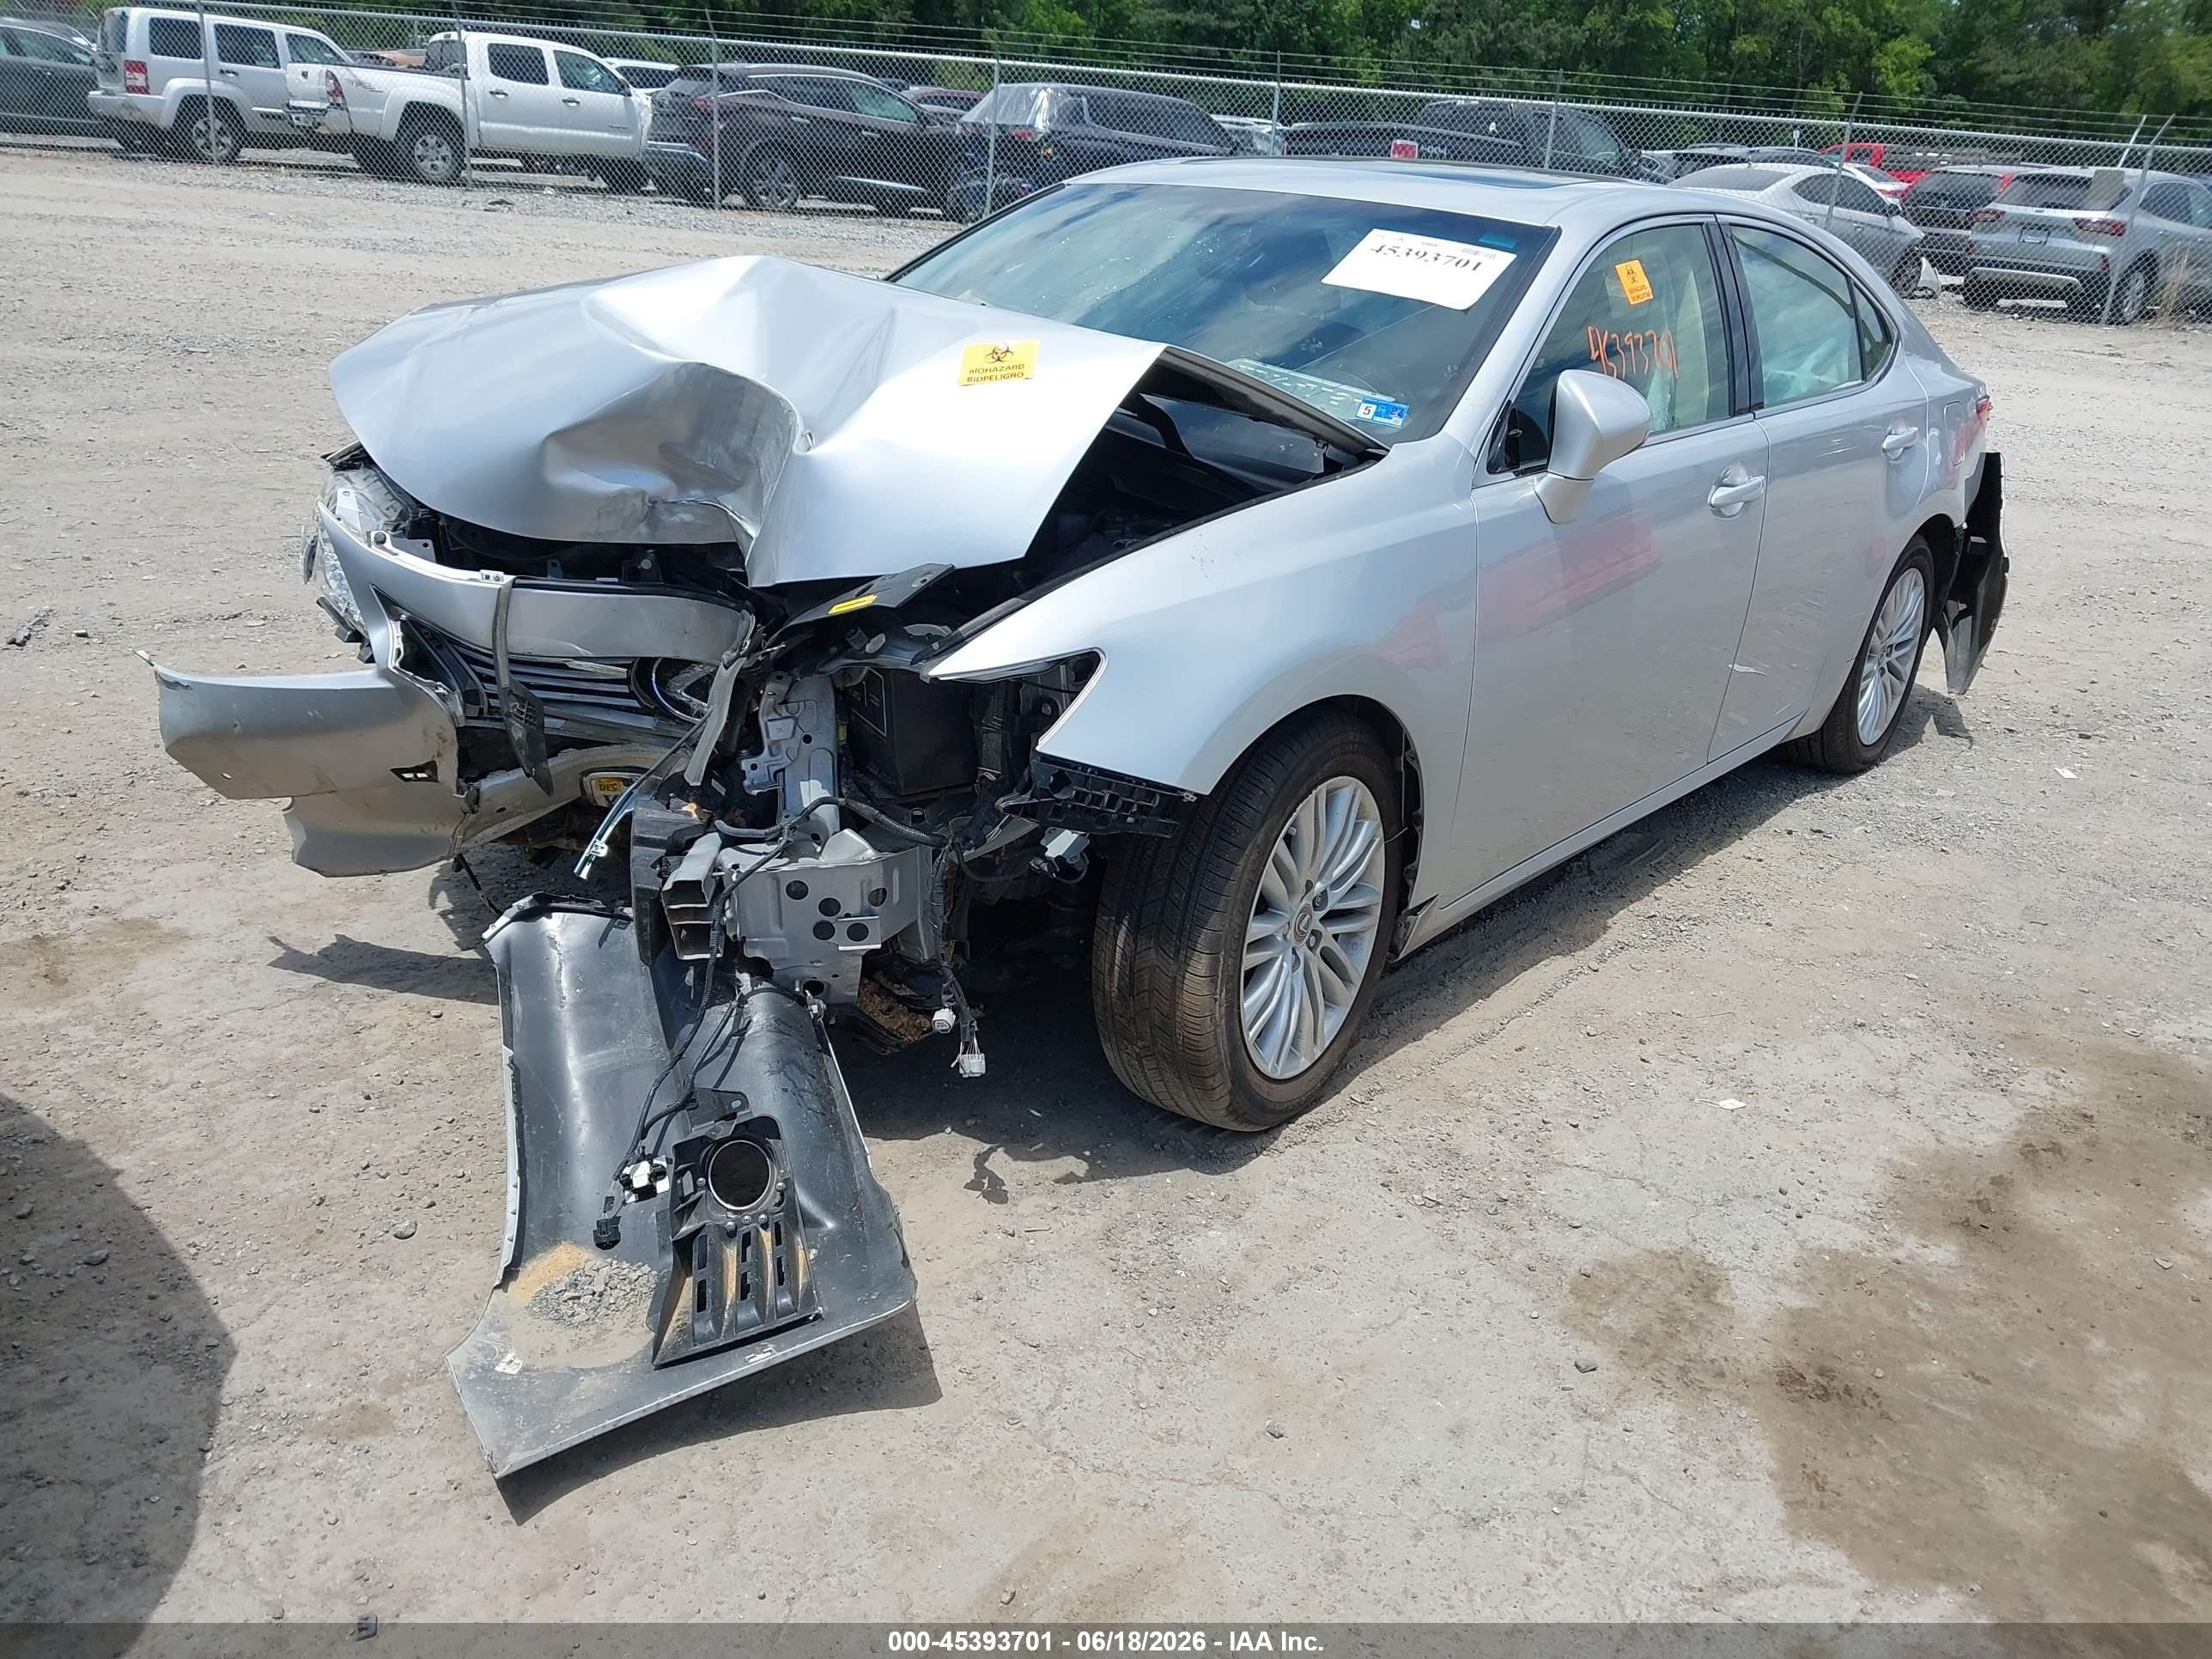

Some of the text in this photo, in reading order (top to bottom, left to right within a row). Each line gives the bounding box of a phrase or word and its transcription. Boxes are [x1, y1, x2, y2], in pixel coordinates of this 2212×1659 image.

[1370, 244, 1484, 272] 45393701
[966, 371, 1024, 383] BIOPELIGRO
[1362, 405, 1373, 416] 5
